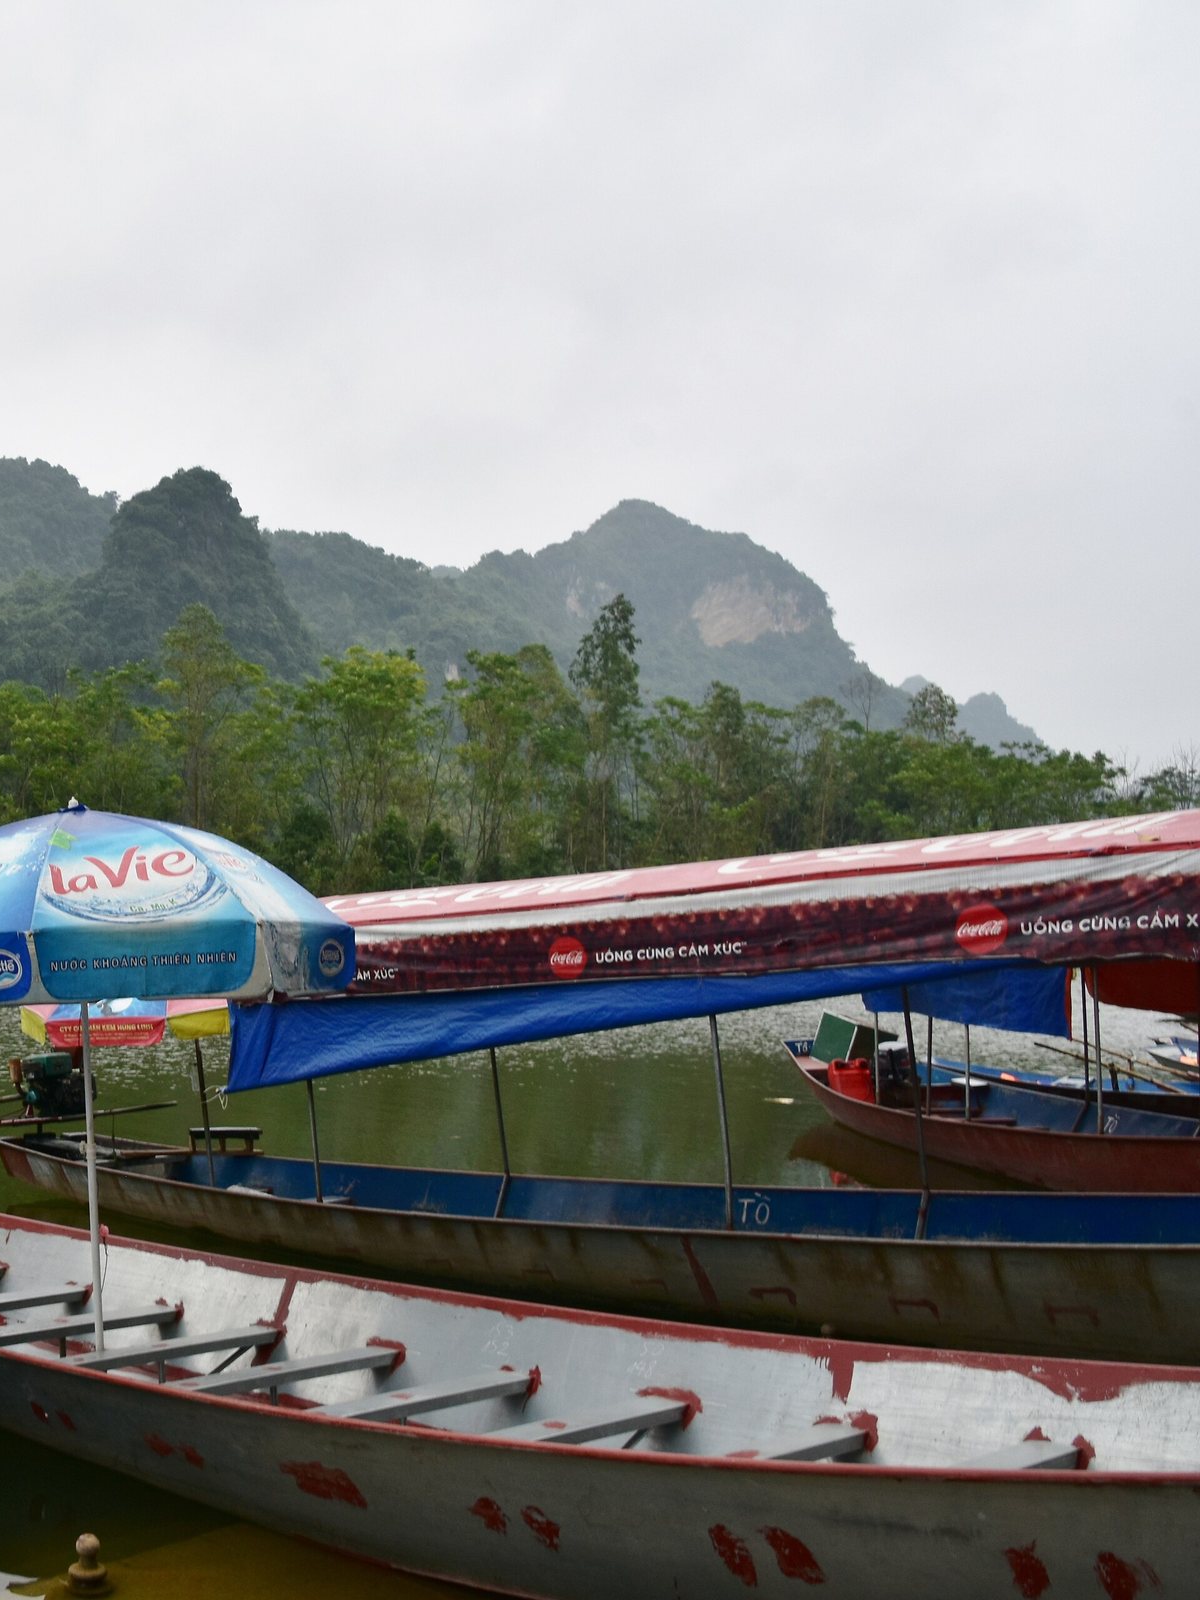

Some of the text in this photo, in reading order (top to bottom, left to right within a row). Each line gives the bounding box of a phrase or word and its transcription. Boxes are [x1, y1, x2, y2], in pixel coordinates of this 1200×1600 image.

[957, 920, 1004, 938] Coca-Cola
[1079, 915, 1131, 931] CÙNG
[1137, 905, 1179, 929] CẢM
[50, 950, 237, 972] NƯỚC KHOÁNG THIÊN NHIÊN
[550, 950, 583, 966] Coca-Cola
[637, 946, 675, 960] CÙNG
[679, 942, 709, 957] CẢM
